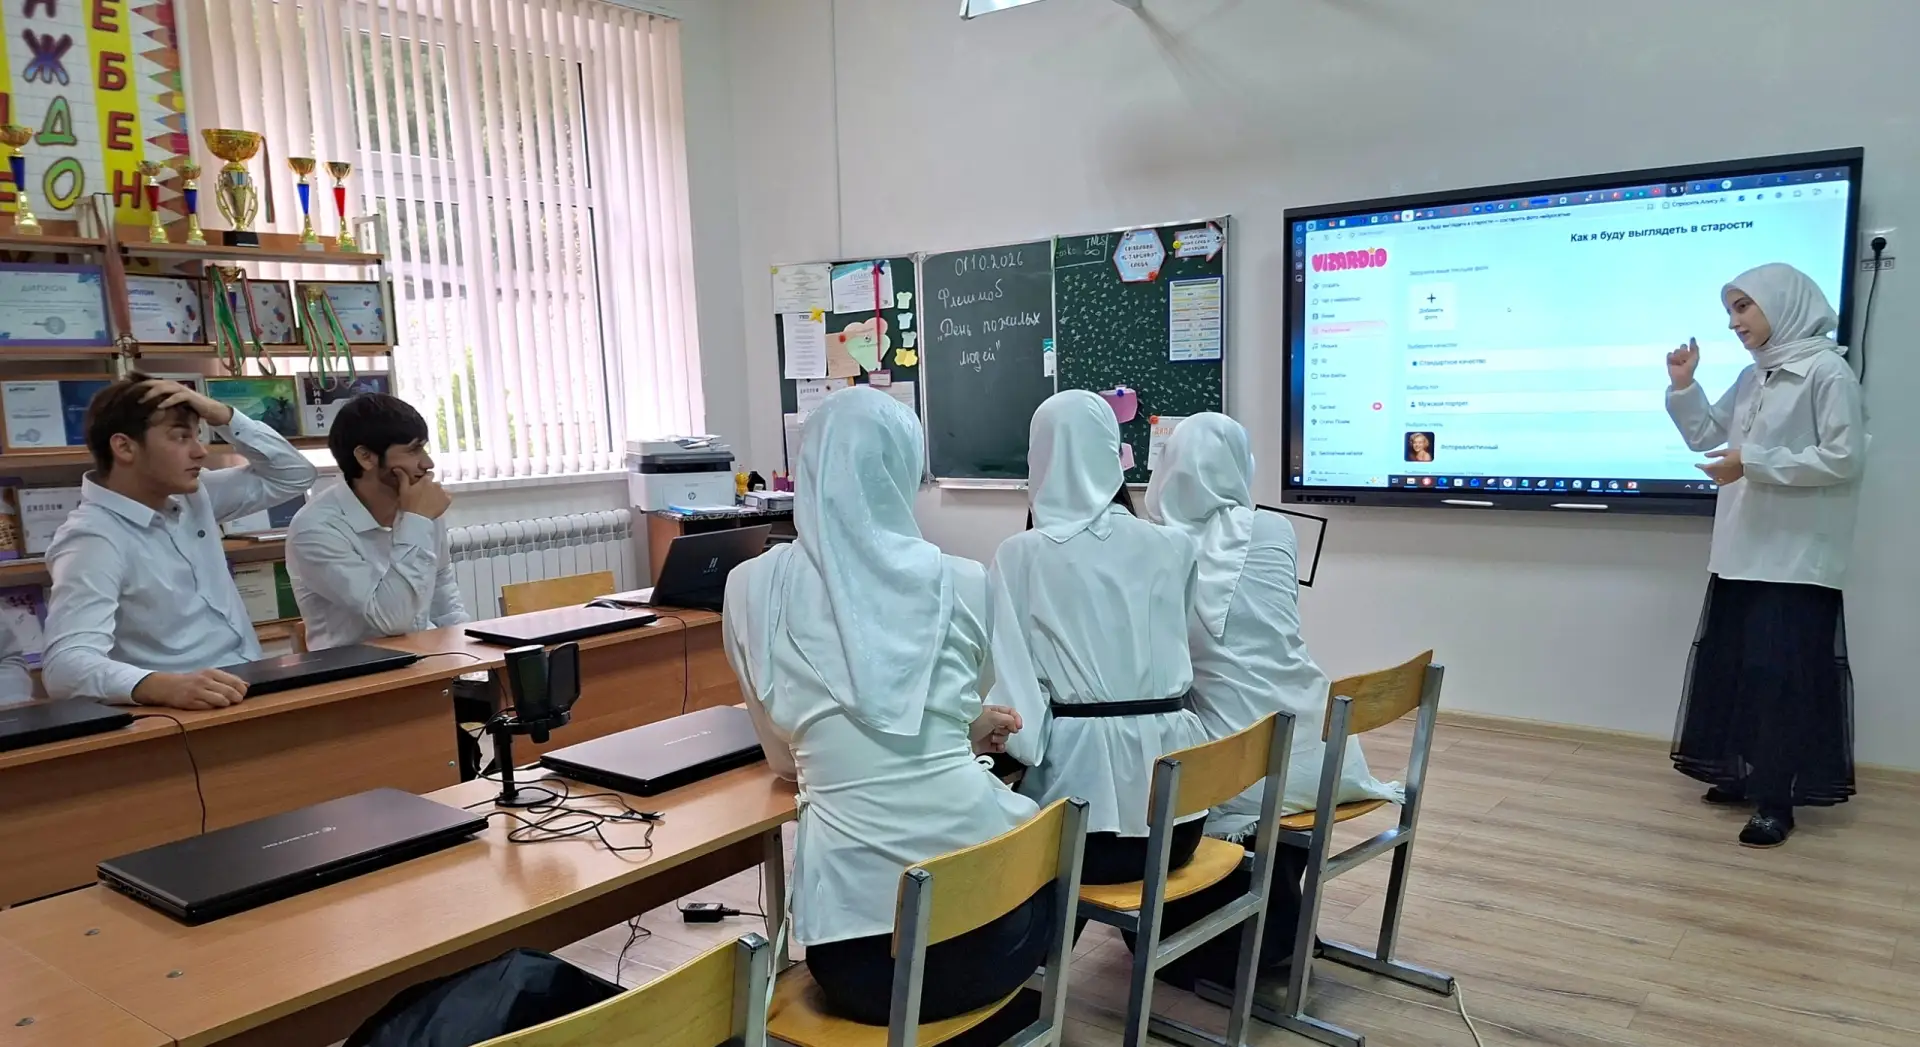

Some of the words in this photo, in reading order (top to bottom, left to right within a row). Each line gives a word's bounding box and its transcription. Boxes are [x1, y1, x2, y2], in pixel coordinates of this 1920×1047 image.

[1570, 232, 1589, 242] Как
[1590, 231, 1598, 241] я
[1600, 230, 1626, 242] буду
[1628, 226, 1688, 239] выглядеть
[1690, 225, 1698, 233] в
[1700, 220, 1753, 234] старости
[937, 279, 1004, 310] Флешмоб
[983, 311, 1041, 334] пожилых
[1419, 359, 1458, 367] Стандартное
